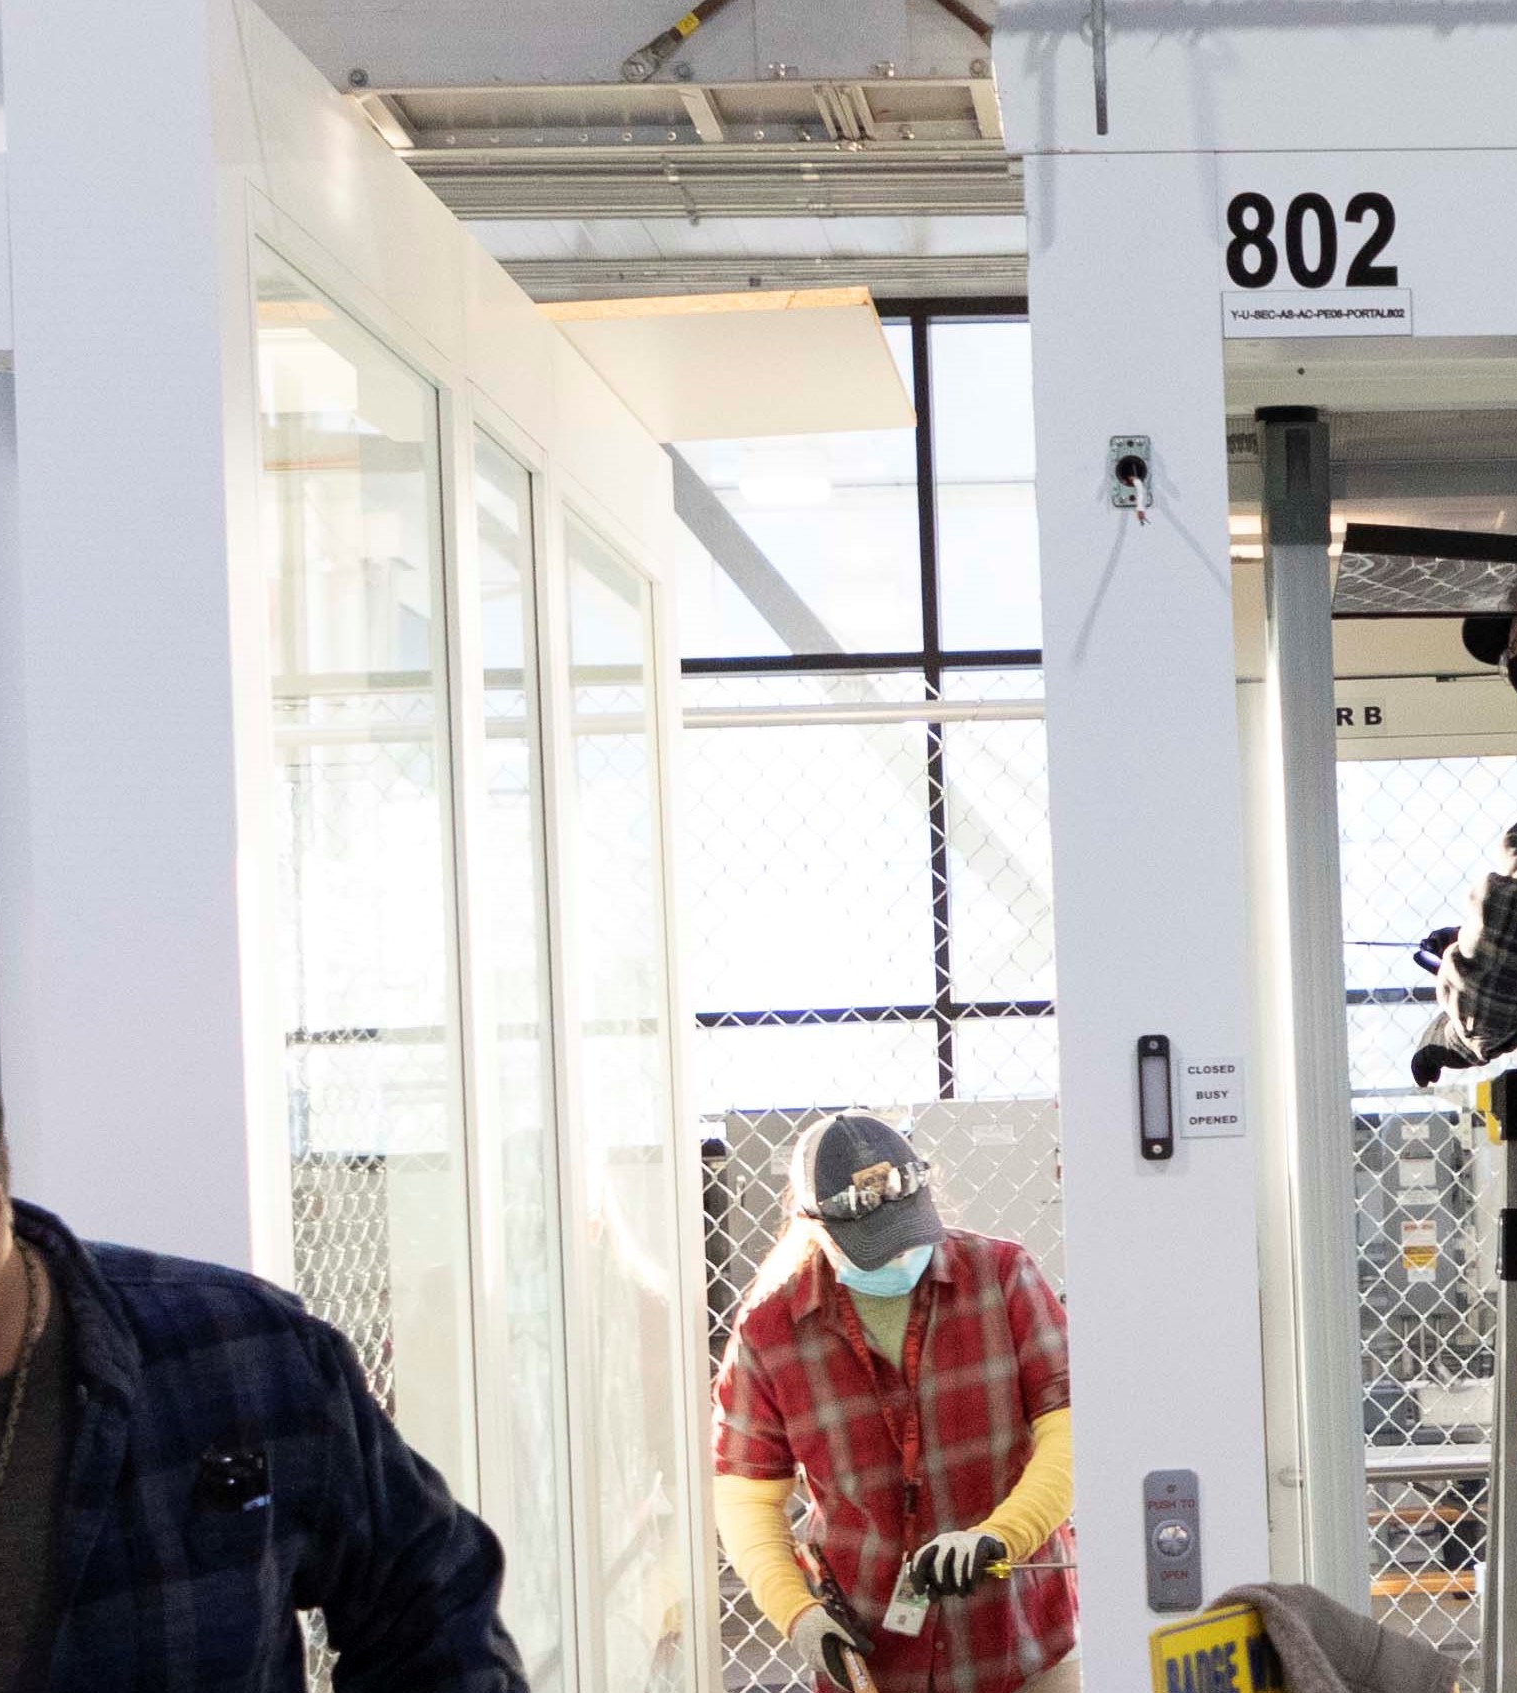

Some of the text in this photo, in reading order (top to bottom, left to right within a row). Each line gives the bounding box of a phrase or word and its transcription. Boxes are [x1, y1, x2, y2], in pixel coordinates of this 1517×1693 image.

[1226, 192, 1398, 288] 802
[1364, 706, 1383, 726] B
[1187, 1064, 1236, 1075] CLOSED
[1195, 1090, 1229, 1100] BUSY
[1188, 1114, 1238, 1126] OPENED
[1148, 1500, 1176, 1511] PUSH
[1162, 1570, 1189, 1581] OPEN
